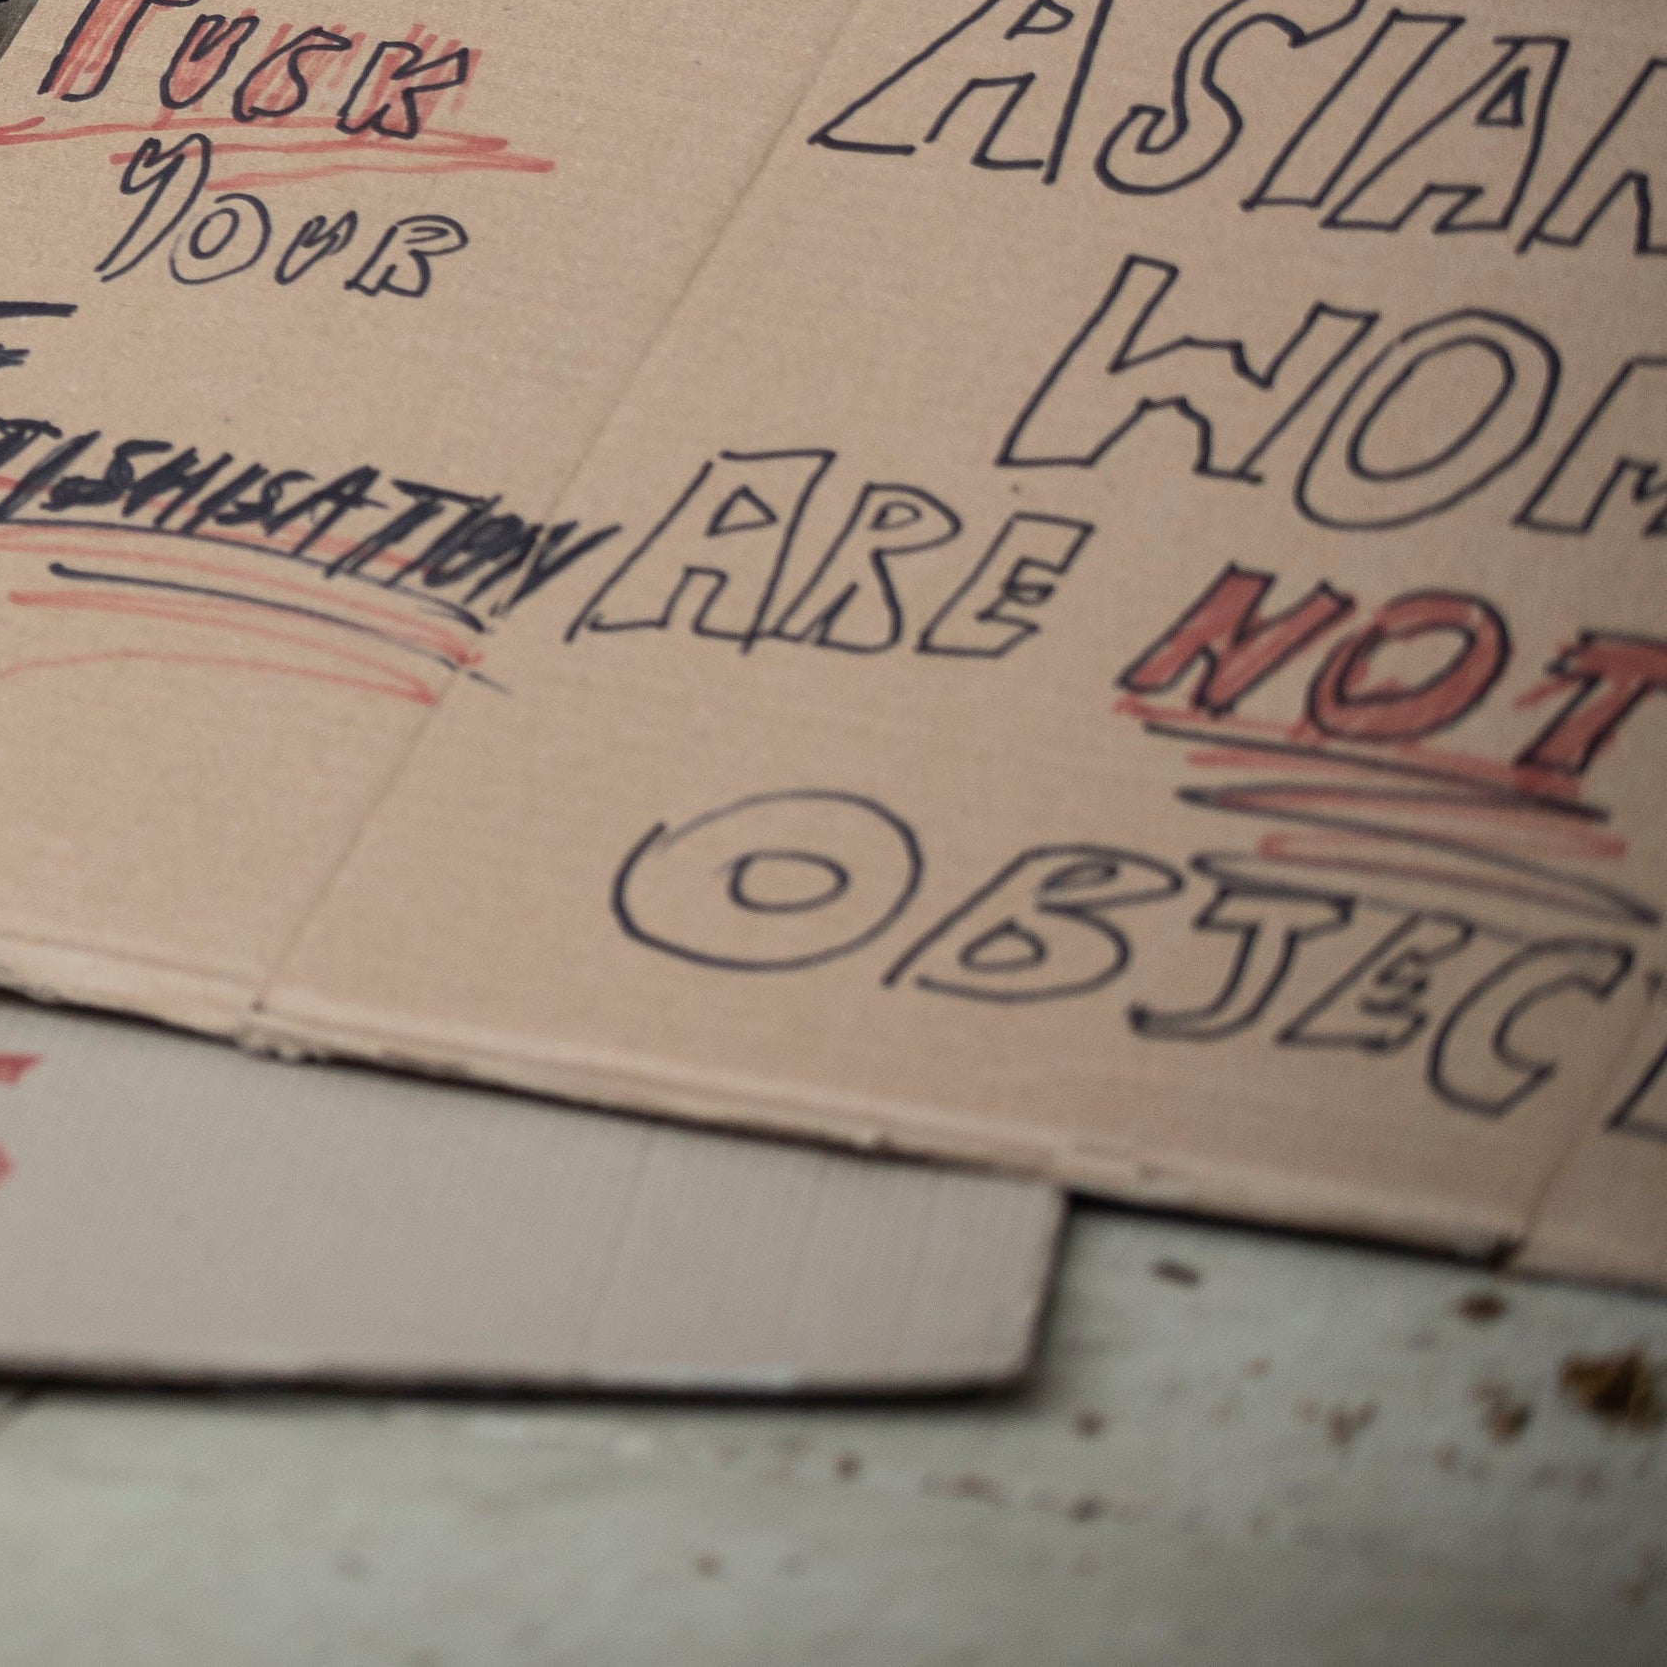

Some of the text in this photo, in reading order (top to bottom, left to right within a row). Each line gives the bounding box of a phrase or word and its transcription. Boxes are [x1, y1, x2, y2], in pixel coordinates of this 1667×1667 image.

[97, 134, 468, 298] YOUR
[566, 448, 1667, 776] ARE NOT
